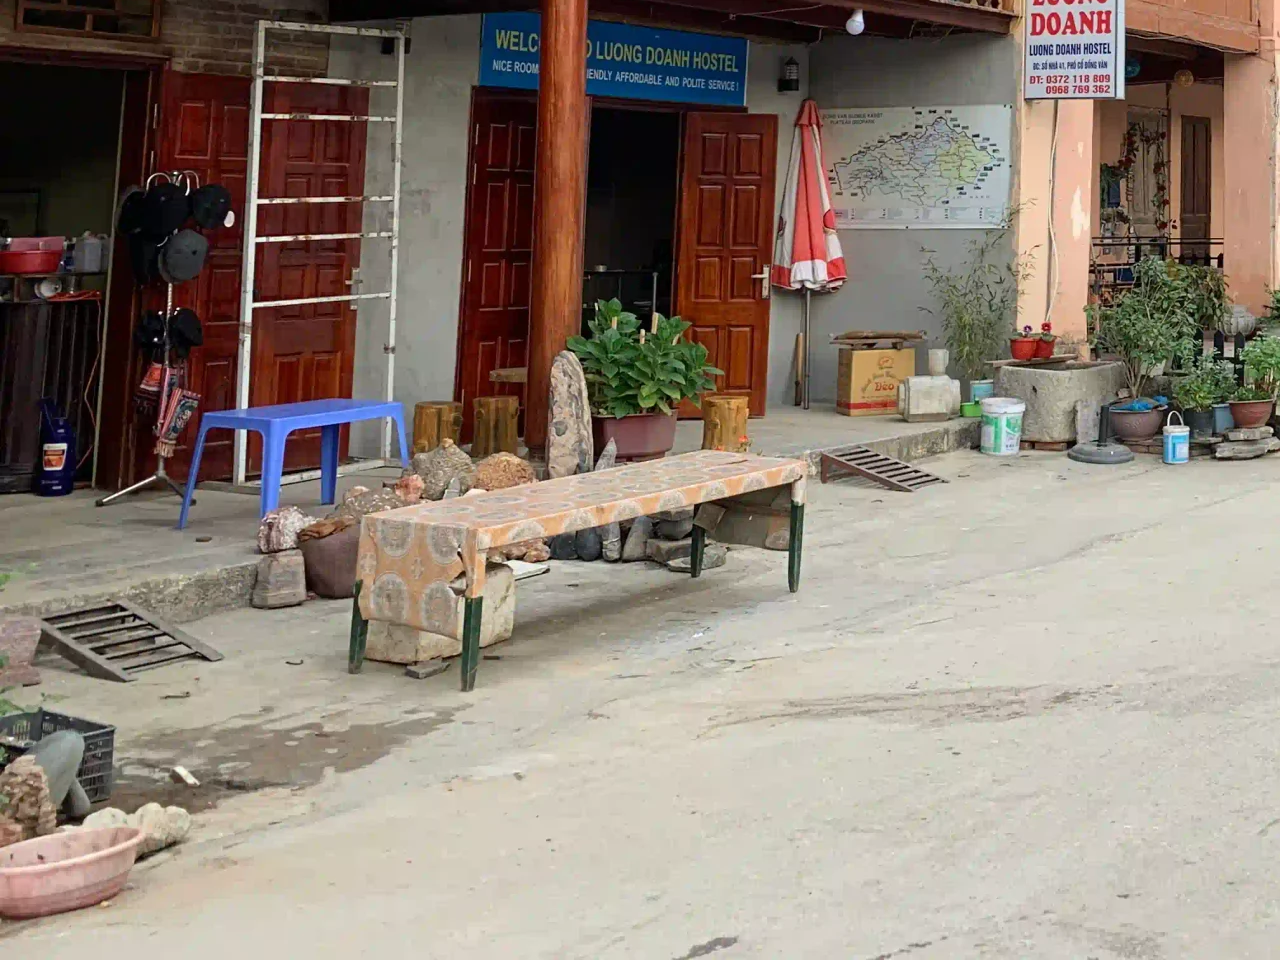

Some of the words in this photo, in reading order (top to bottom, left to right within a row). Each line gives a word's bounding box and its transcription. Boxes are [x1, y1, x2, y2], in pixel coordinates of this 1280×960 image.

[1030, 10, 1112, 36] DOANH
[496, 28, 541, 53] WELC
[596, 40, 642, 64] LUONG
[646, 46, 690, 68] DOANH
[693, 52, 739, 72] HOSTEL
[1029, 44, 1053, 57] LUONG
[1055, 43, 1081, 56] DOANH
[1083, 42, 1111, 55] HOSTEL
[492, 59, 512, 72] NICE
[586, 68, 613, 81] IENDLY
[615, 71, 662, 86] AFFORDABLE
[665, 75, 680, 87] AND
[682, 76, 706, 89] POLITE
[1046, 75, 1069, 84] 0372
[1072, 74, 1089, 83] 118
